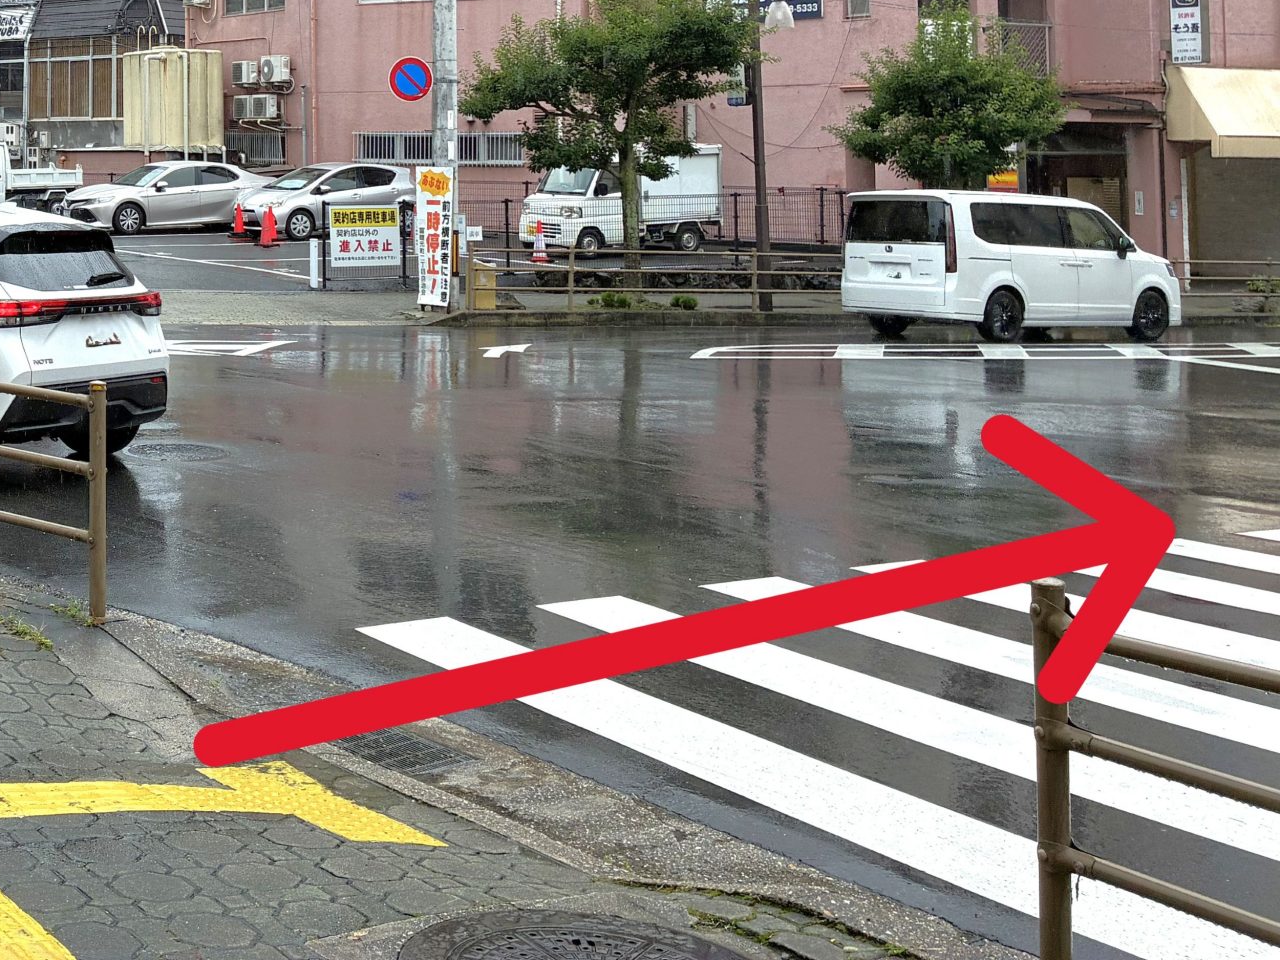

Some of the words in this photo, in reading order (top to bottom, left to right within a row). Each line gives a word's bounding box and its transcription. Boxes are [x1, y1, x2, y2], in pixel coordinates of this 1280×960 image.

[421, 174, 449, 191] あぶない
[333, 211, 396, 224] 契約店専用駐車場
[336, 229, 379, 237] 契約店以外の
[339, 239, 393, 253] 進入禁止
[440, 200, 451, 303] 前方横断者に注意
